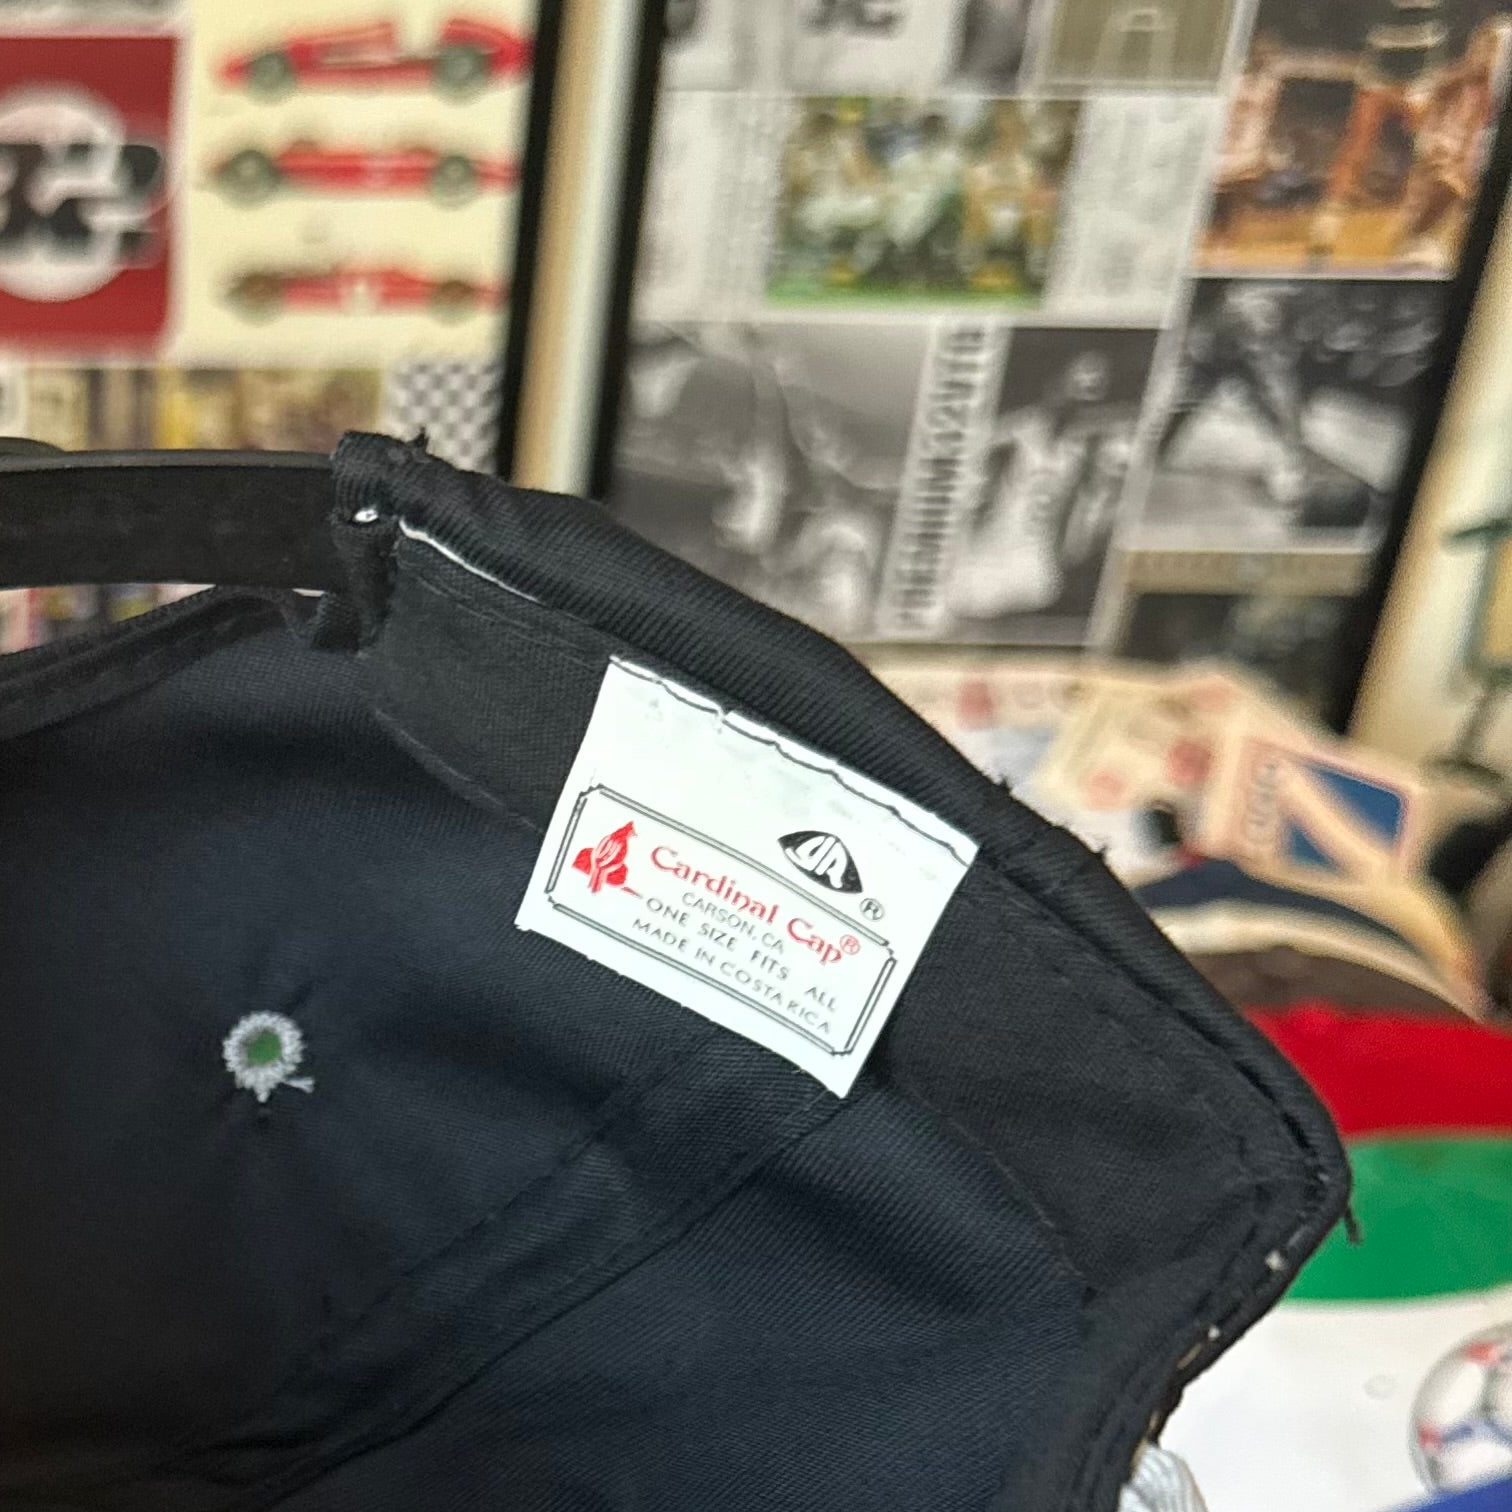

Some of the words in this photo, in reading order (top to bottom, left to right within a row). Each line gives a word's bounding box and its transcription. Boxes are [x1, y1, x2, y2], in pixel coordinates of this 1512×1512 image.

[650, 845, 780, 924] Cardinal
[632, 917, 690, 952] MADE
[694, 946, 716, 967] IN
[719, 960, 784, 1006] COSTA
[787, 999, 832, 1035] RICA
[645, 896, 690, 928] ONE
[697, 921, 739, 952] SIZE
[749, 948, 791, 982] FITS
[803, 985, 838, 1013] ALL
[761, 932, 786, 956] CA
